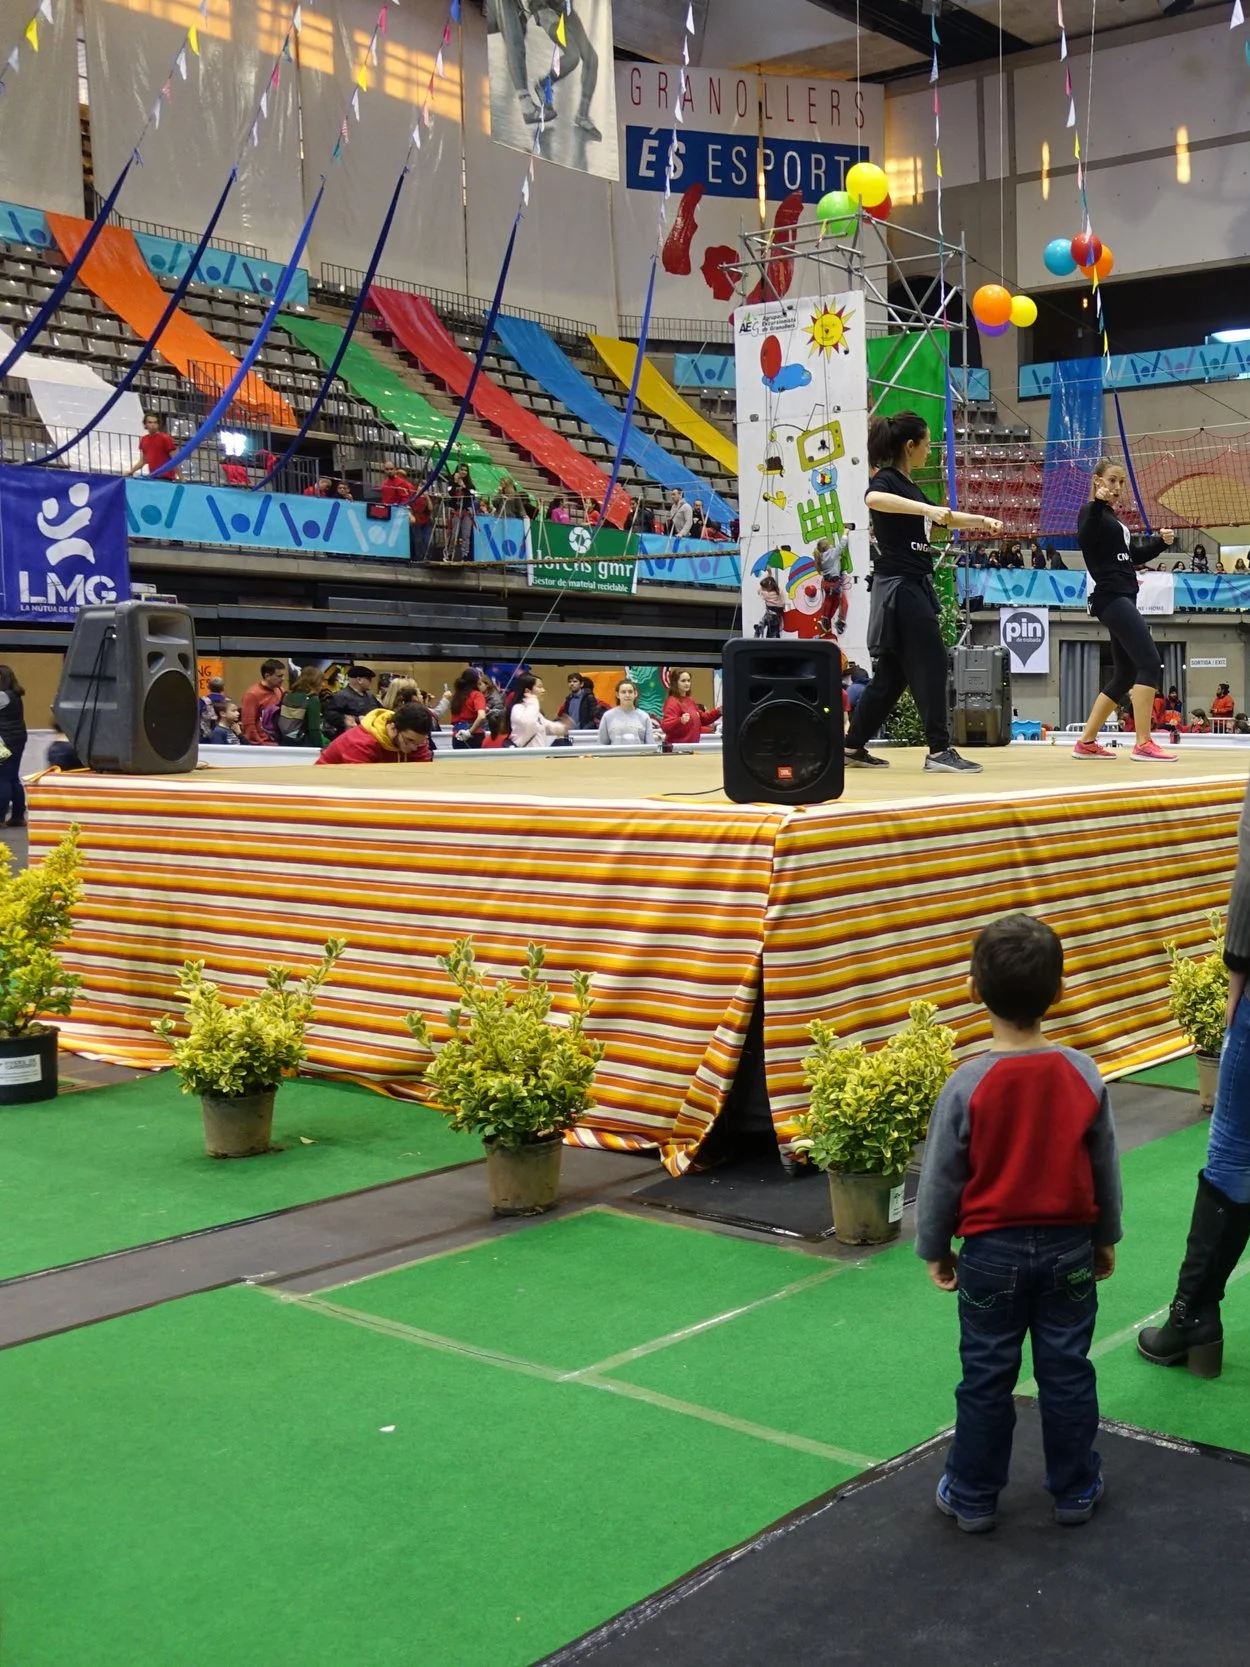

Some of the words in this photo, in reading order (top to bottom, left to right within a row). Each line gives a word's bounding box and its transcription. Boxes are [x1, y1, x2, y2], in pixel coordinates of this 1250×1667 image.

[630, 67, 865, 129] GRANOLLERS
[638, 127, 687, 180] ÉS
[707, 143, 851, 192] ESPORT
[598, 561, 634, 580] gmr
[18, 570, 118, 606] LMG
[557, 578, 567, 587] de
[597, 583, 629, 593] reciclable
[31, 604, 57, 613] MÚTUA
[1005, 617, 1042, 643] pin
